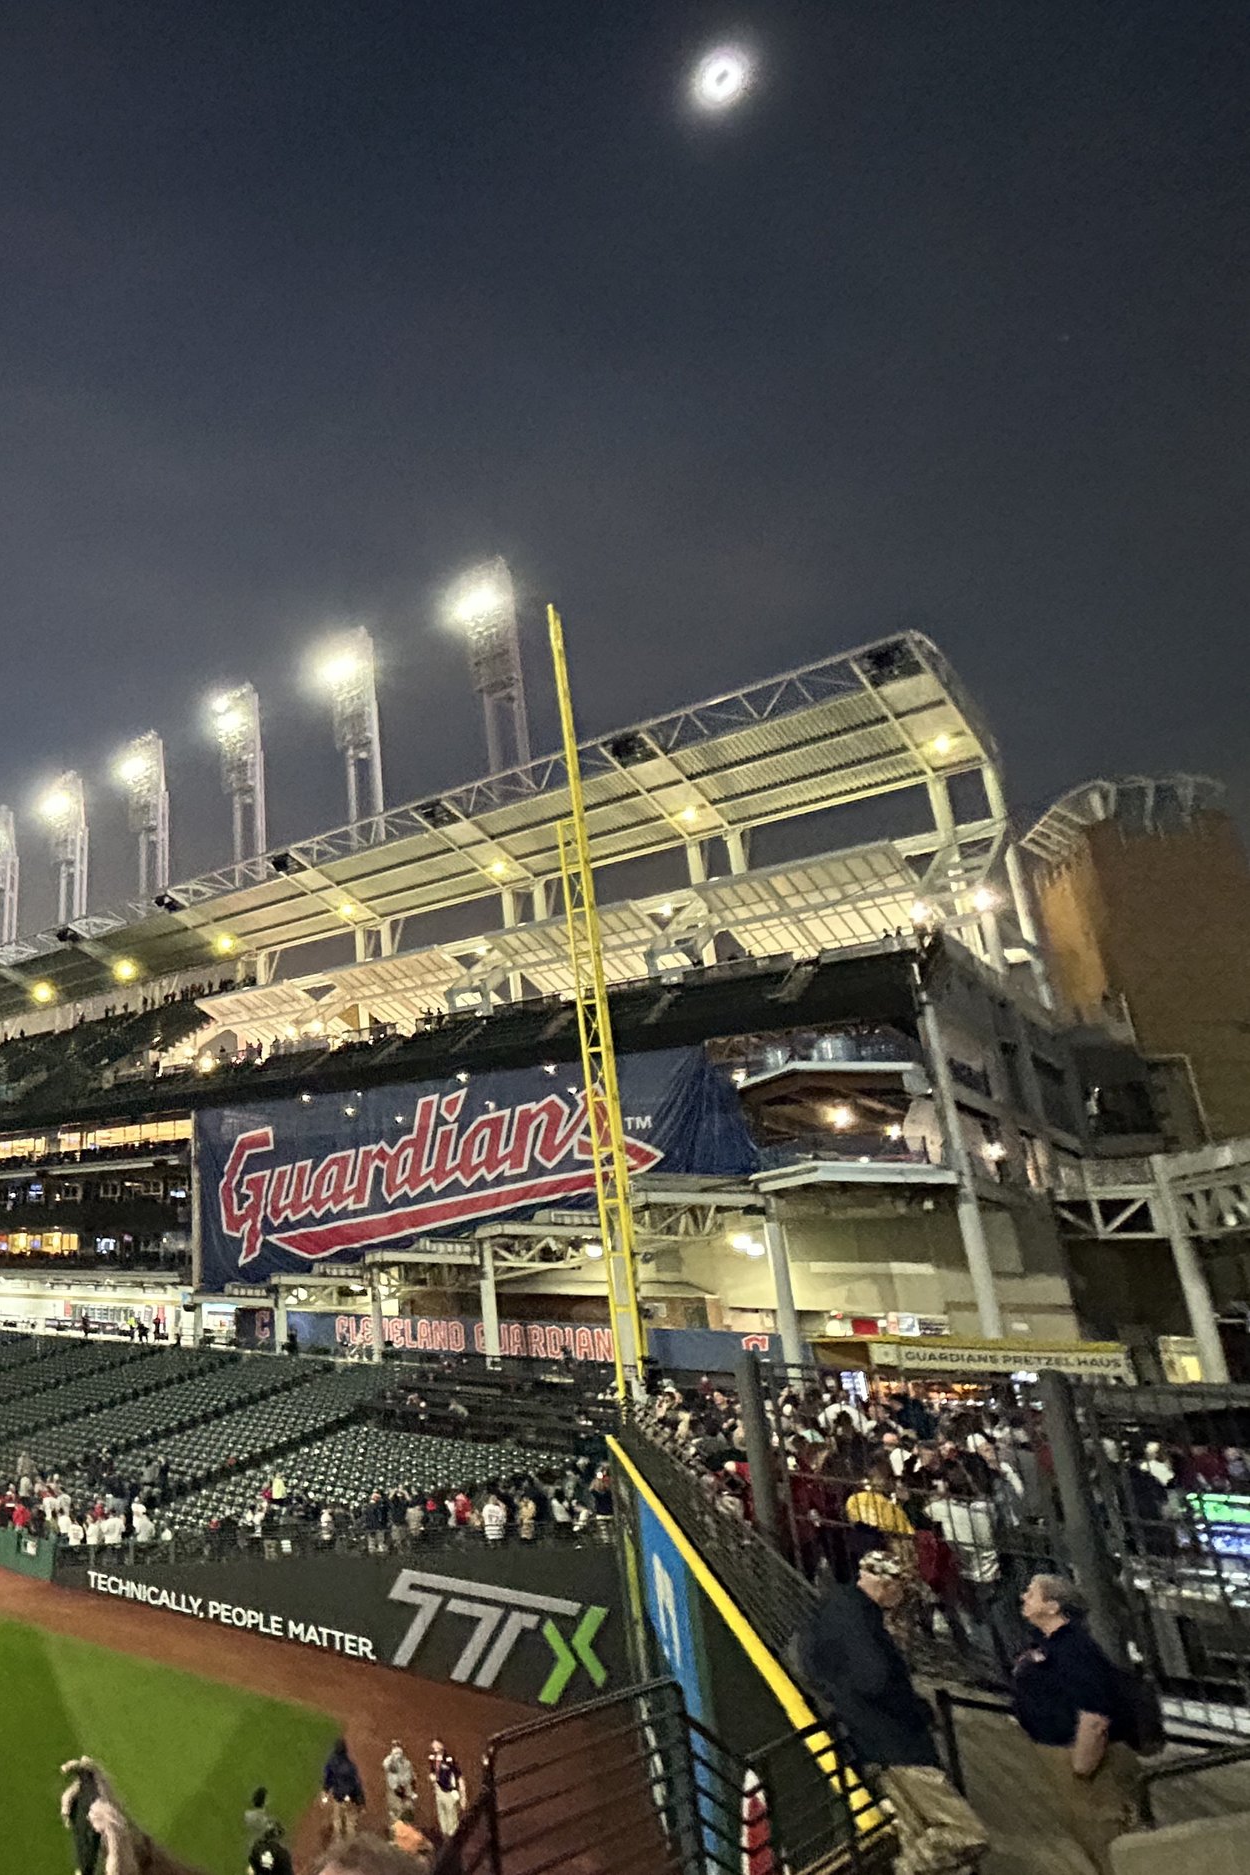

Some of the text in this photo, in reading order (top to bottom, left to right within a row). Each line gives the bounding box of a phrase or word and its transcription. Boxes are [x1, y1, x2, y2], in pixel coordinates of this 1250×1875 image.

[623, 1115, 653, 1131] TM
[218, 1082, 665, 1267] Guardians
[473, 1321, 616, 1363] GUARDIAN
[904, 1350, 1122, 1369] GUARDIANS PRETZEL HAUS
[87, 1570, 377, 1660] TECHNICALLY, PEOPLE MATTER.
[387, 1568, 609, 1705] TTX
